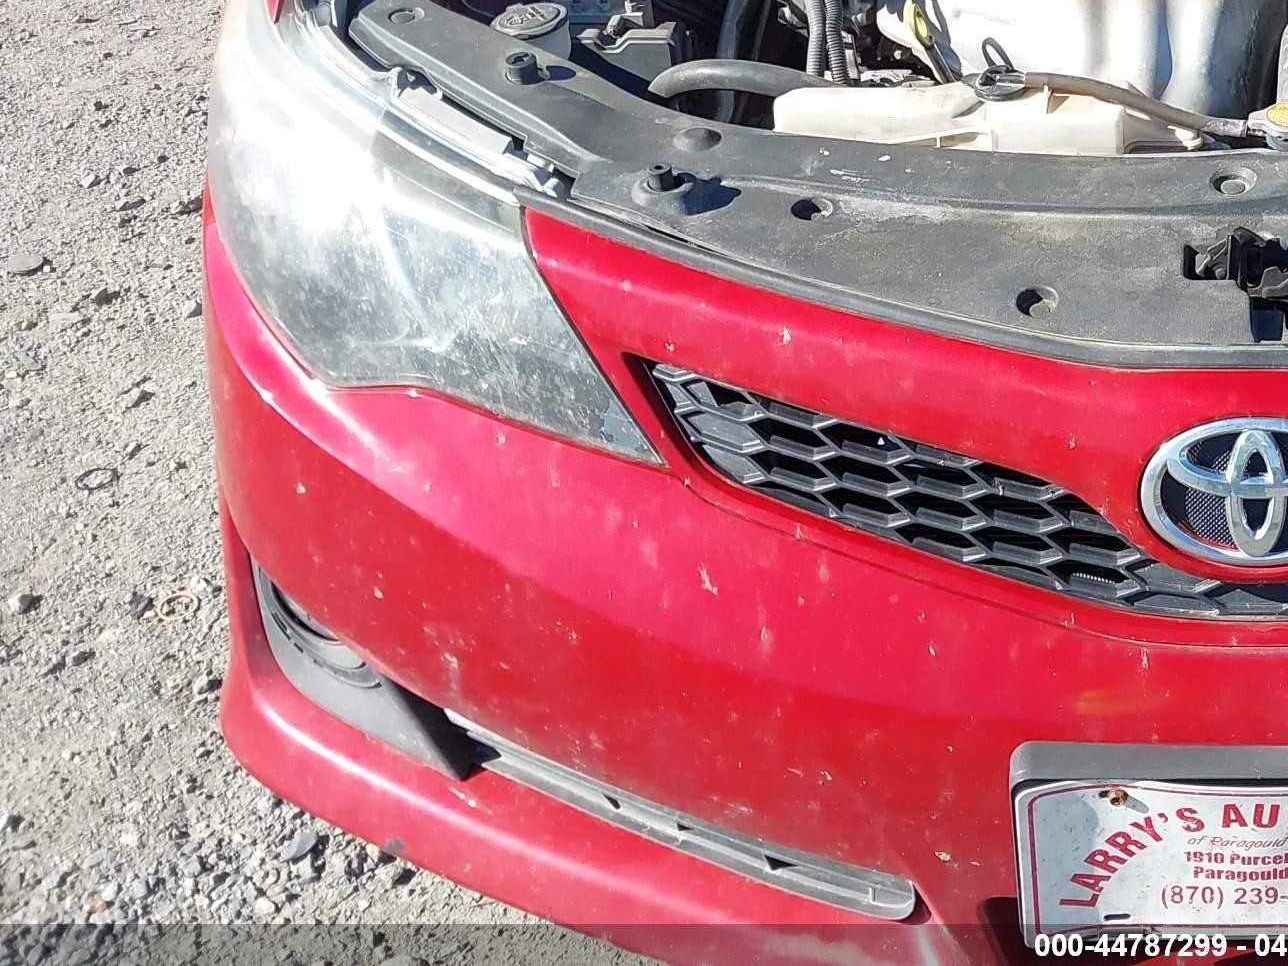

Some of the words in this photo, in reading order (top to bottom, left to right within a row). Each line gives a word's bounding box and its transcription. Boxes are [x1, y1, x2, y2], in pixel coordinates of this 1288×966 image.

[1187, 835, 1206, 845] of
[1209, 834, 1287, 851] Paragould
[1058, 807, 1206, 908] LARRY'S
[1184, 851, 1225, 865] 1910
[1161, 885, 1224, 910] (870)
